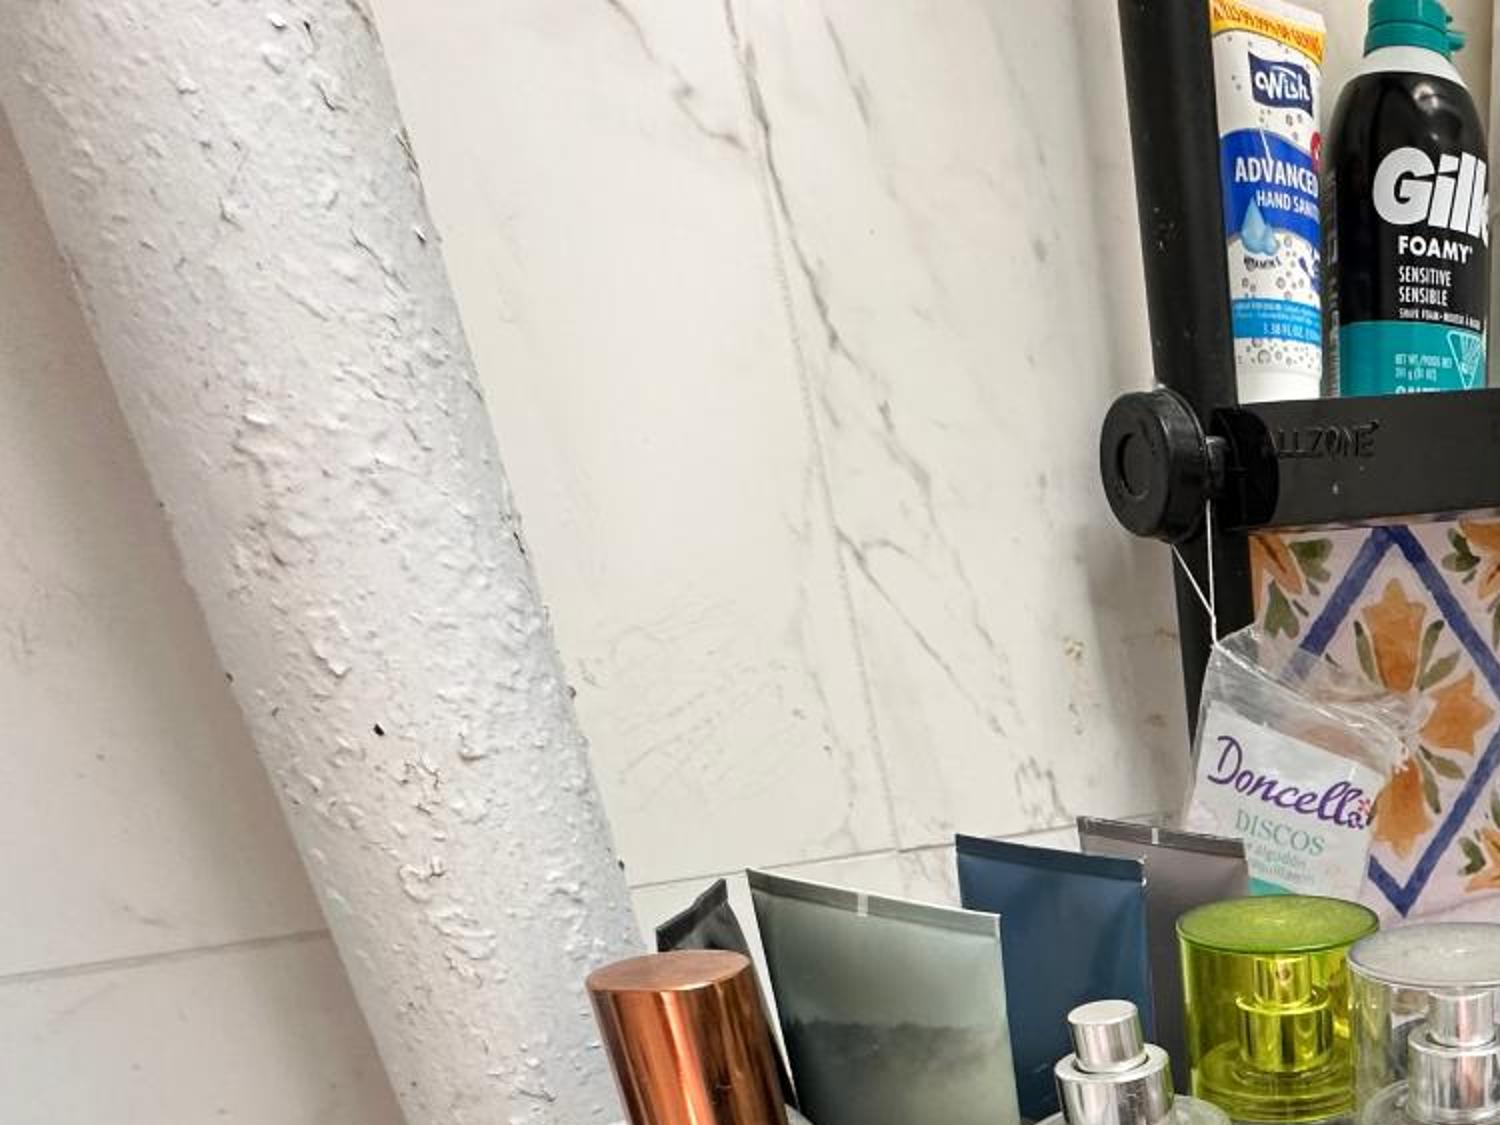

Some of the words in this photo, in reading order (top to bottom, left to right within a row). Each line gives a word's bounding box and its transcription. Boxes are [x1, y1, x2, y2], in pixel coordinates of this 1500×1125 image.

[1256, 190, 1291, 211] HAND
[1293, 197, 1319, 223] SANI
[1373, 147, 1489, 248] Gill
[1398, 235, 1467, 264] FOAMY
[1399, 266, 1452, 287] SENSITIVE
[1399, 286, 1449, 306] SENSIBLE
[1207, 735, 1365, 829] Doncella
[1236, 808, 1326, 855] DISCOS
